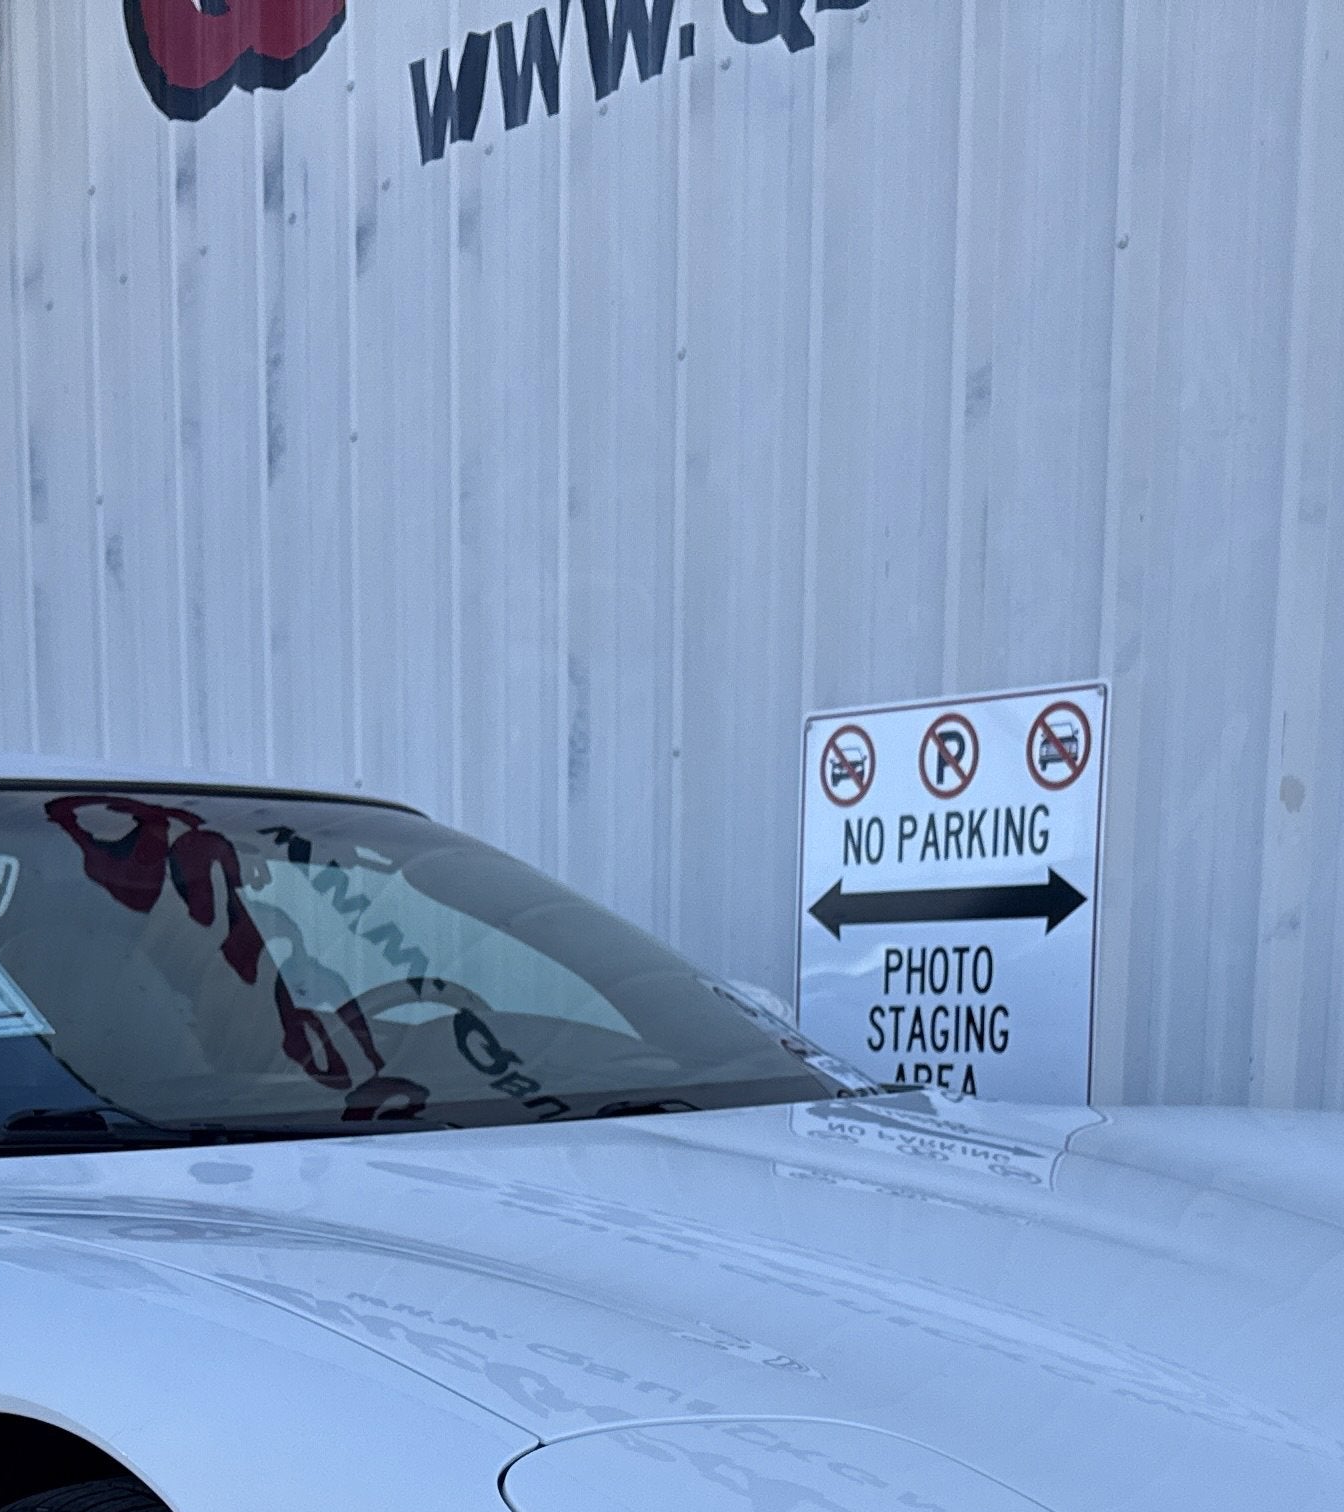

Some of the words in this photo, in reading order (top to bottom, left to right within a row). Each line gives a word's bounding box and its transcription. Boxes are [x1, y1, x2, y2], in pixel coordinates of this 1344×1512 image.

[842, 816, 885, 866] NO
[897, 804, 1051, 863] PARKING
[883, 945, 994, 995] PHOTO
[866, 1005, 1010, 1053] STAGING
